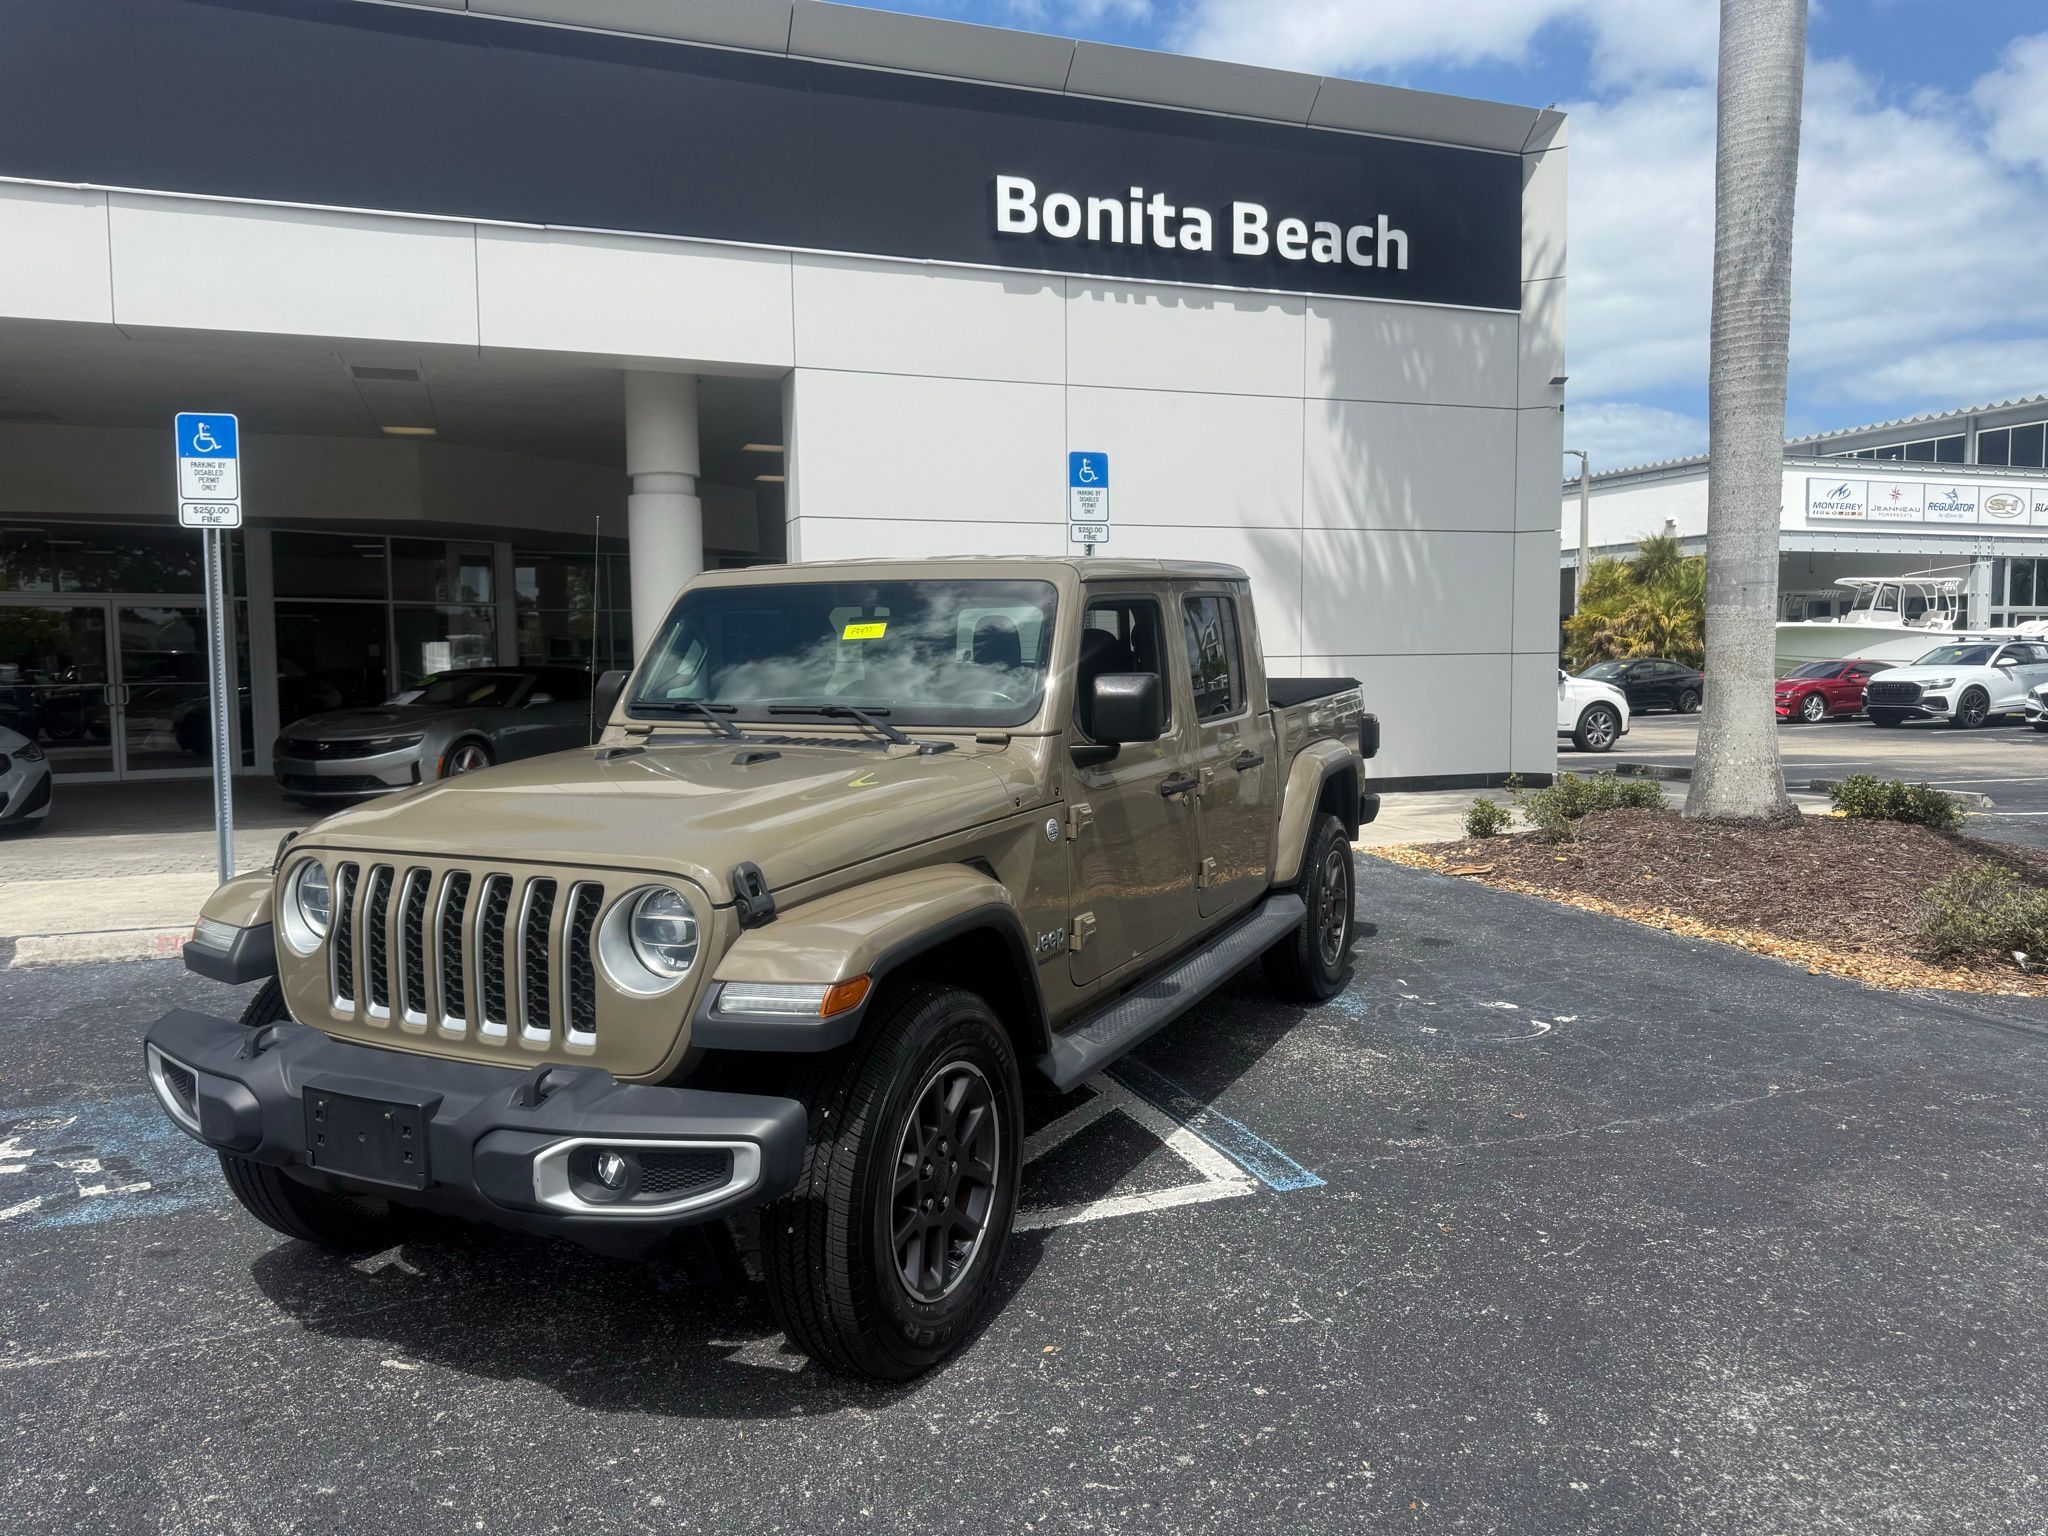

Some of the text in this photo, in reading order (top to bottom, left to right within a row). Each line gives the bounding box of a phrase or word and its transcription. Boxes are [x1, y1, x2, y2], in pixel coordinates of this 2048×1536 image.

[996, 174, 1409, 270] Bonita Beach
[190, 461, 216, 469] PARKING
[193, 506, 229, 514] $250.00
[1812, 501, 1863, 511] MONTEREY
[1870, 504, 1921, 512] JEANNEAU
[1927, 502, 1975, 512] REGULATOR
[201, 515, 222, 523] FINE
[1033, 927, 1064, 952] Jeep
